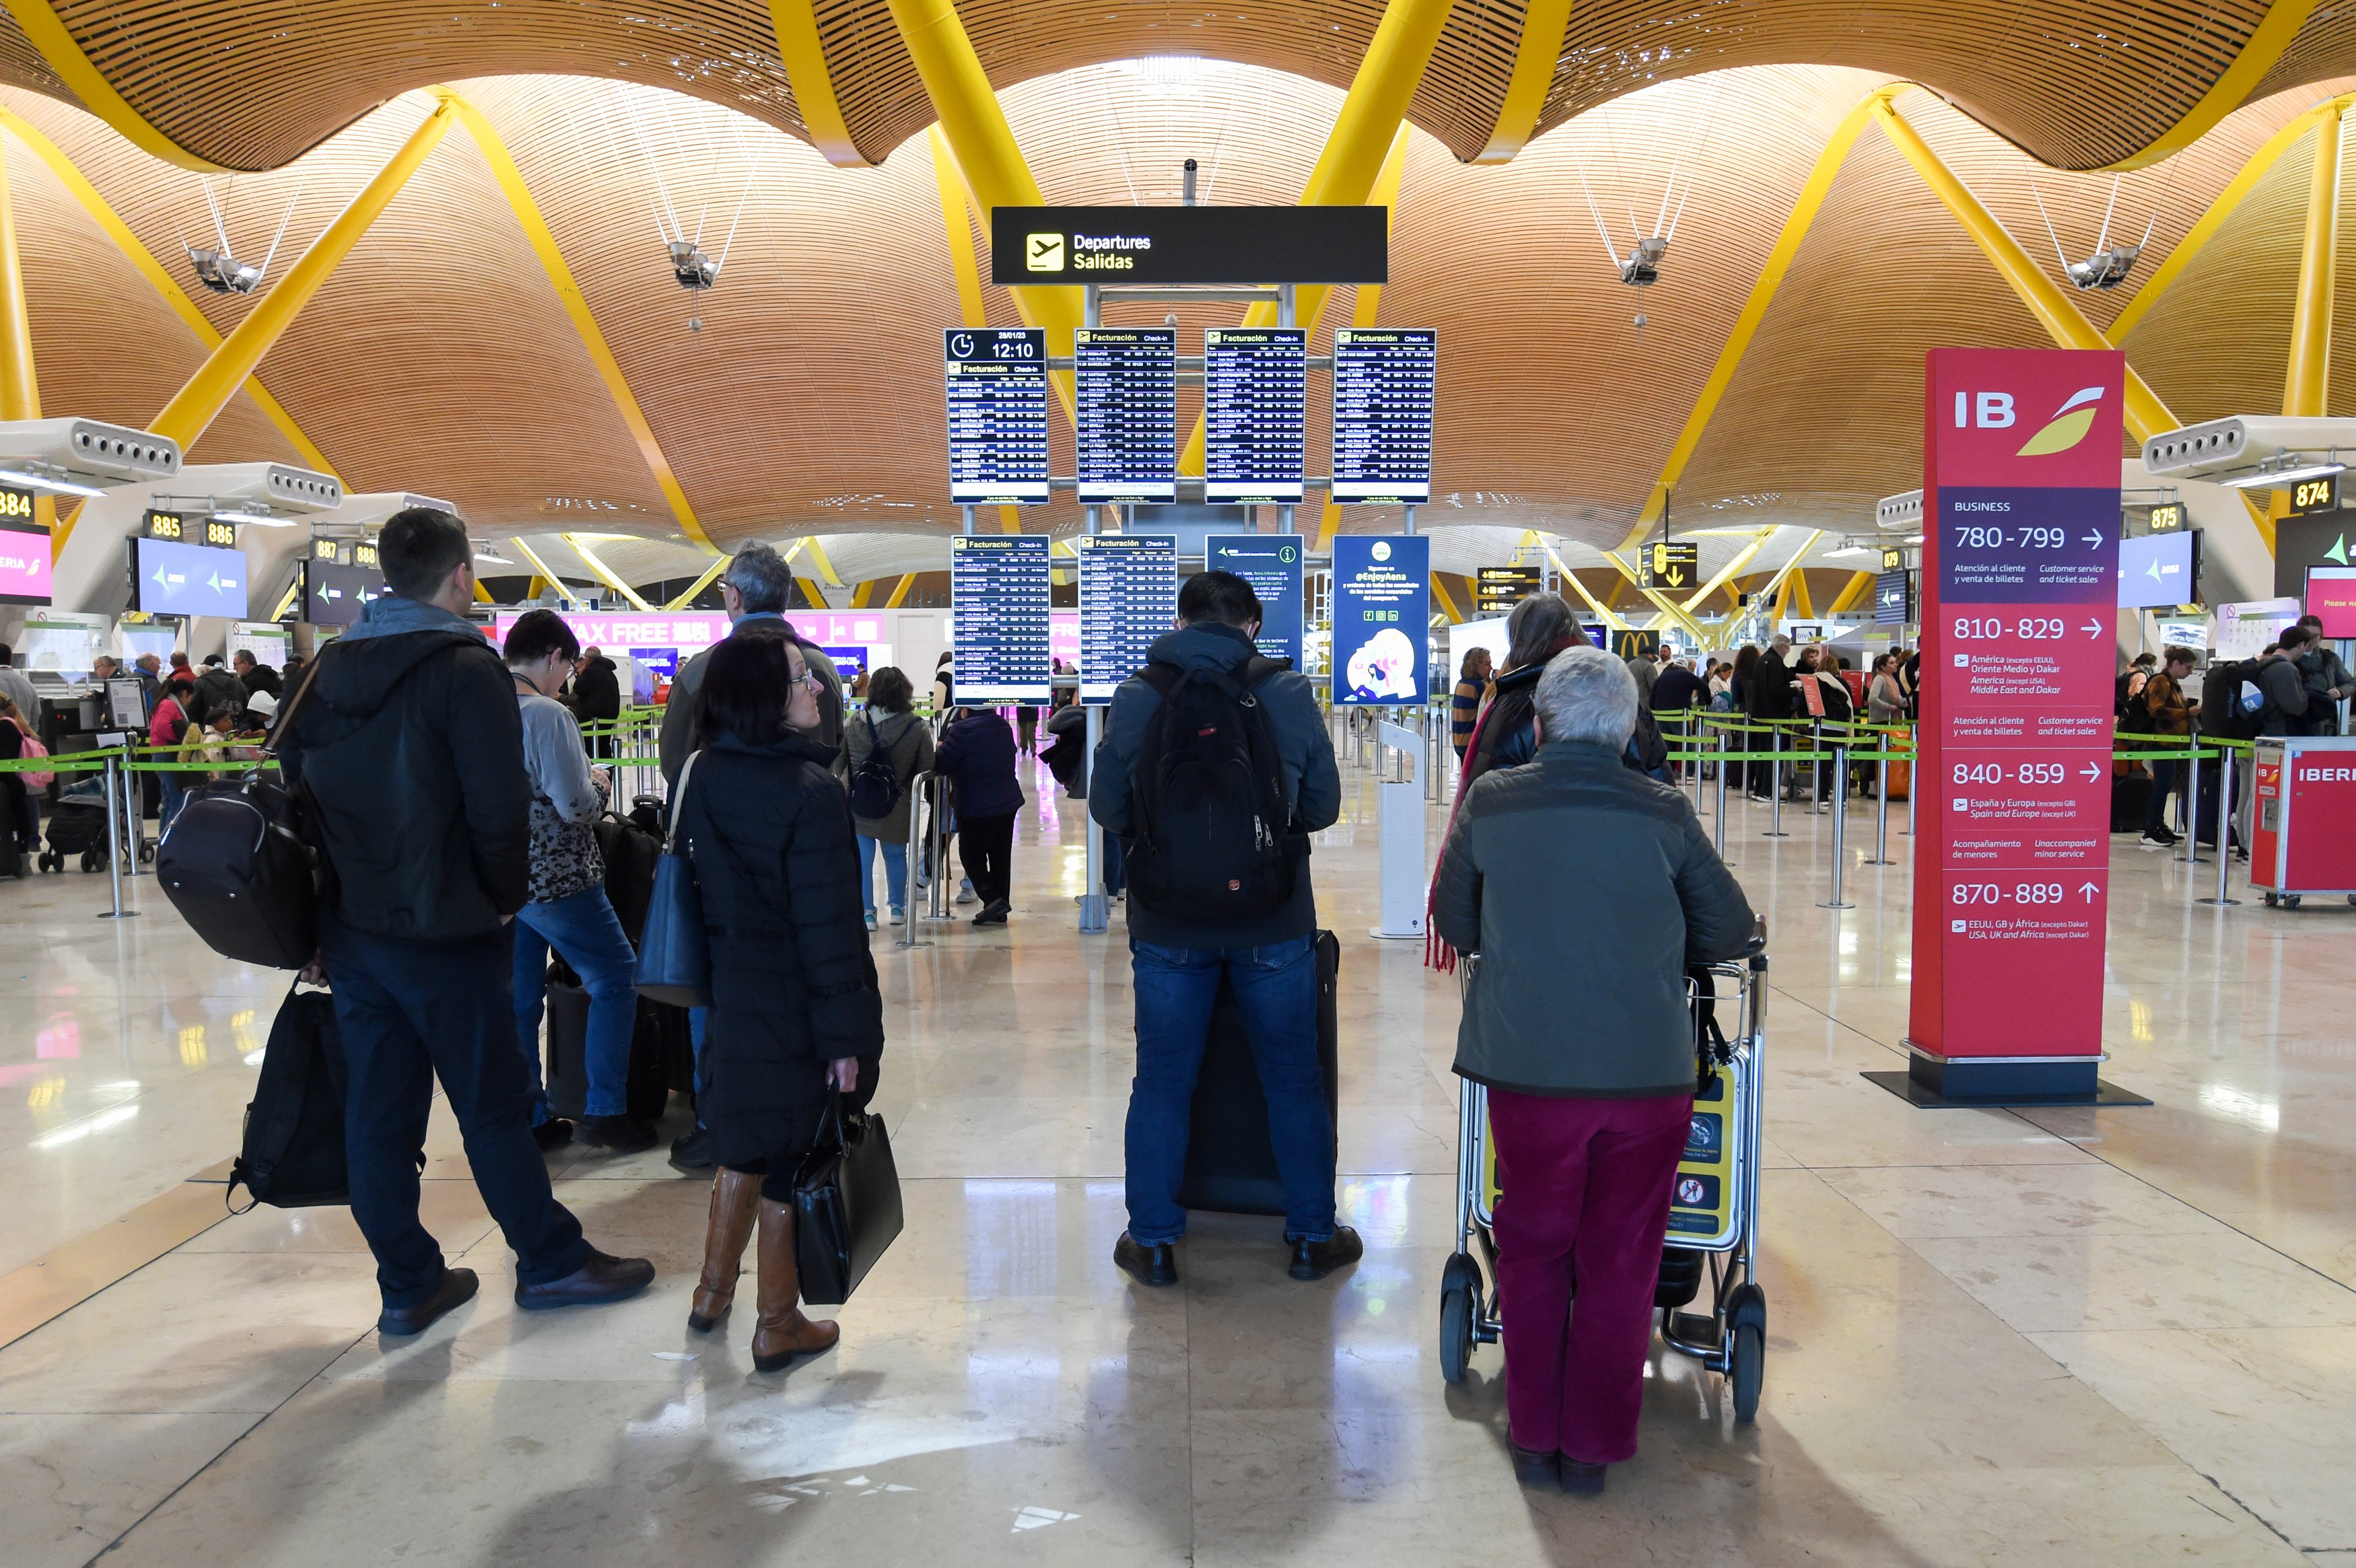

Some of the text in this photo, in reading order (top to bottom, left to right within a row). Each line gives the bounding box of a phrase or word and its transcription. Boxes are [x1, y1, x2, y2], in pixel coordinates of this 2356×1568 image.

[1074, 234, 1151, 252] Departures
[1074, 253, 1134, 270] Salidas
[992, 343, 1033, 357] 12:10
[963, 365, 1008, 373] Facturación
[1955, 392, 2015, 428] IB
[2296, 480, 2329, 507] 874
[1955, 502, 2011, 512] BUSINESS
[2151, 507, 2177, 529] 875
[153, 515, 180, 537] 885
[209, 523, 234, 544] 886
[318, 540, 337, 559] 887
[357, 546, 376, 564] 888
[1883, 551, 1899, 568] 879
[1954, 563, 2026, 573] Atención al cliente
[2039, 564, 2105, 573] Customer service
[2161, 563, 2180, 574] aena
[168, 573, 185, 583] aena
[1356, 573, 1406, 582] @EnjoyAena
[1954, 574, 2024, 585] y venta de billetes
[2039, 575, 2098, 583] and ticket sales
[221, 579, 237, 588] aena
[613, 622, 668, 643] FREE
[1971, 655, 2006, 664] América
[2006, 657, 2033, 665] (excepto
[1971, 664, 2060, 675] Oriente Medio y Dakar
[1970, 676, 2005, 684] America
[2029, 677, 2046, 685] USA),
[1970, 685, 2061, 694] Middle East and Dakar
[1953, 716, 2025, 725] Atención al cliente
[2038, 716, 2104, 725] Customer service
[1953, 727, 2023, 738] y venta de billetes
[2038, 727, 2097, 736] and ticket sales
[2258, 769, 2267, 777] IB
[1970, 799, 1999, 809] España
[2000, 801, 2006, 809] y
[2007, 798, 2036, 809] Europa
[2037, 800, 2064, 808] (excepto
[1970, 809, 1993, 820] Spain
[1994, 809, 2011, 818] and
[2011, 809, 2040, 819] Europe
[2041, 811, 2064, 819] (except
[1952, 839, 2021, 849] Acompañamiento
[2034, 839, 2097, 849] Unaccompanied
[1952, 850, 1963, 859] de
[2034, 849, 2085, 858] minor service
[1968, 920, 1994, 929] EEUU,
[1995, 920, 2008, 929] GB
[2009, 922, 2014, 931] y
[2015, 917, 2040, 928] África
[2040, 921, 2067, 929] (excepto
[1968, 931, 1988, 940] USA,
[1989, 931, 2003, 939] UK
[2003, 930, 2019, 939] and
[2019, 929, 2044, 939] Africa
[2046, 931, 2069, 939] (except
